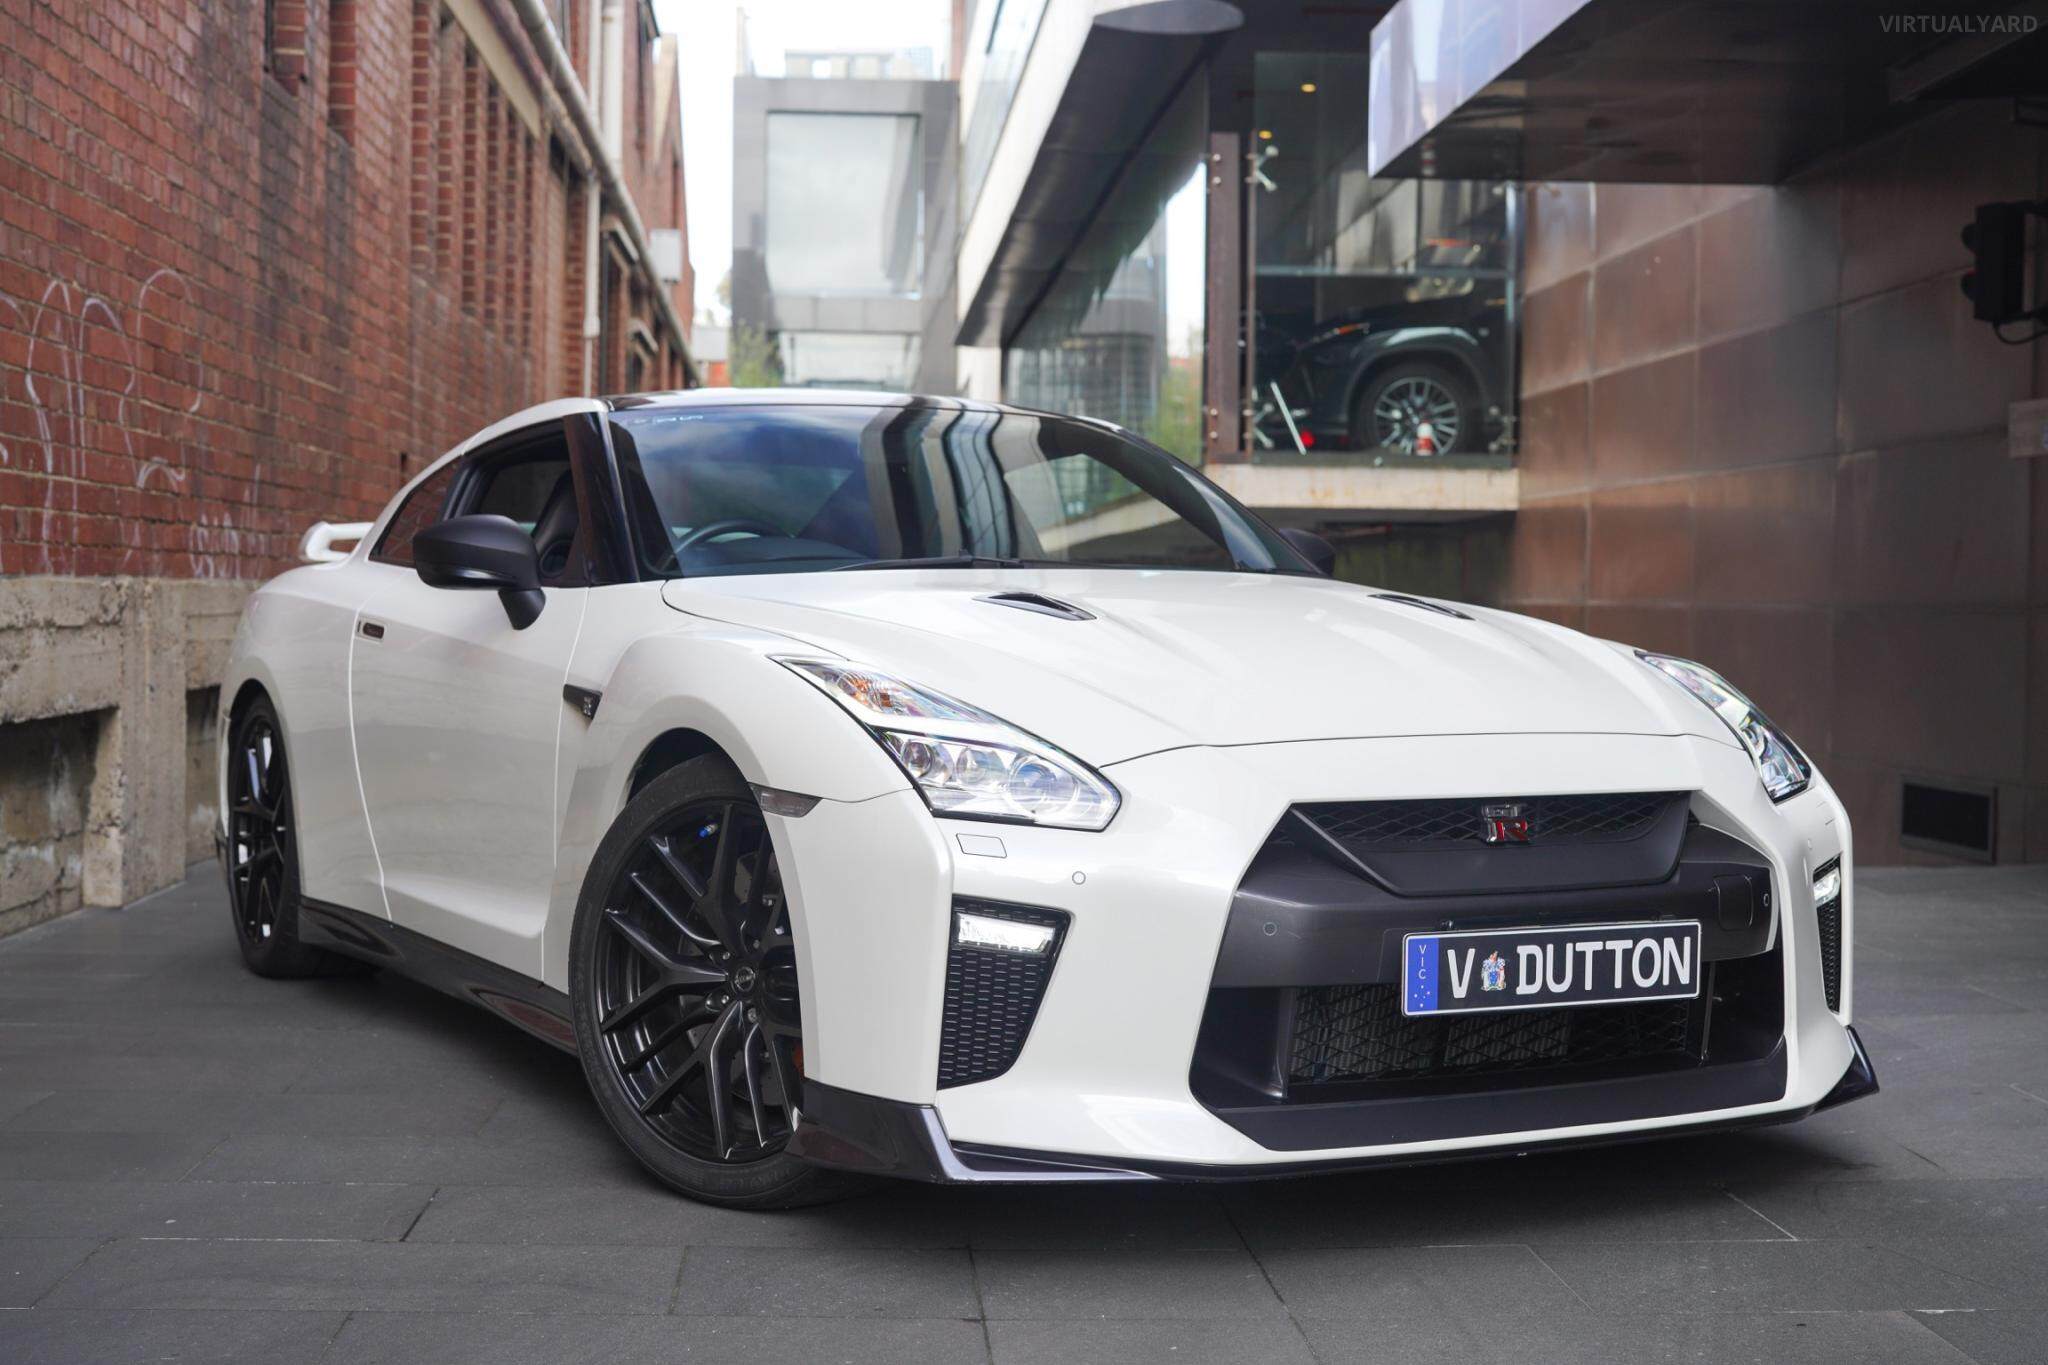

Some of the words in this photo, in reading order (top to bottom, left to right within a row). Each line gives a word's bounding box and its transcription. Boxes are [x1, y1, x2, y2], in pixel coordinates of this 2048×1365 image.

[1418, 944, 1427, 980] VIC
[1447, 948, 1475, 999] V
[1516, 936, 1691, 995] DUTTON
